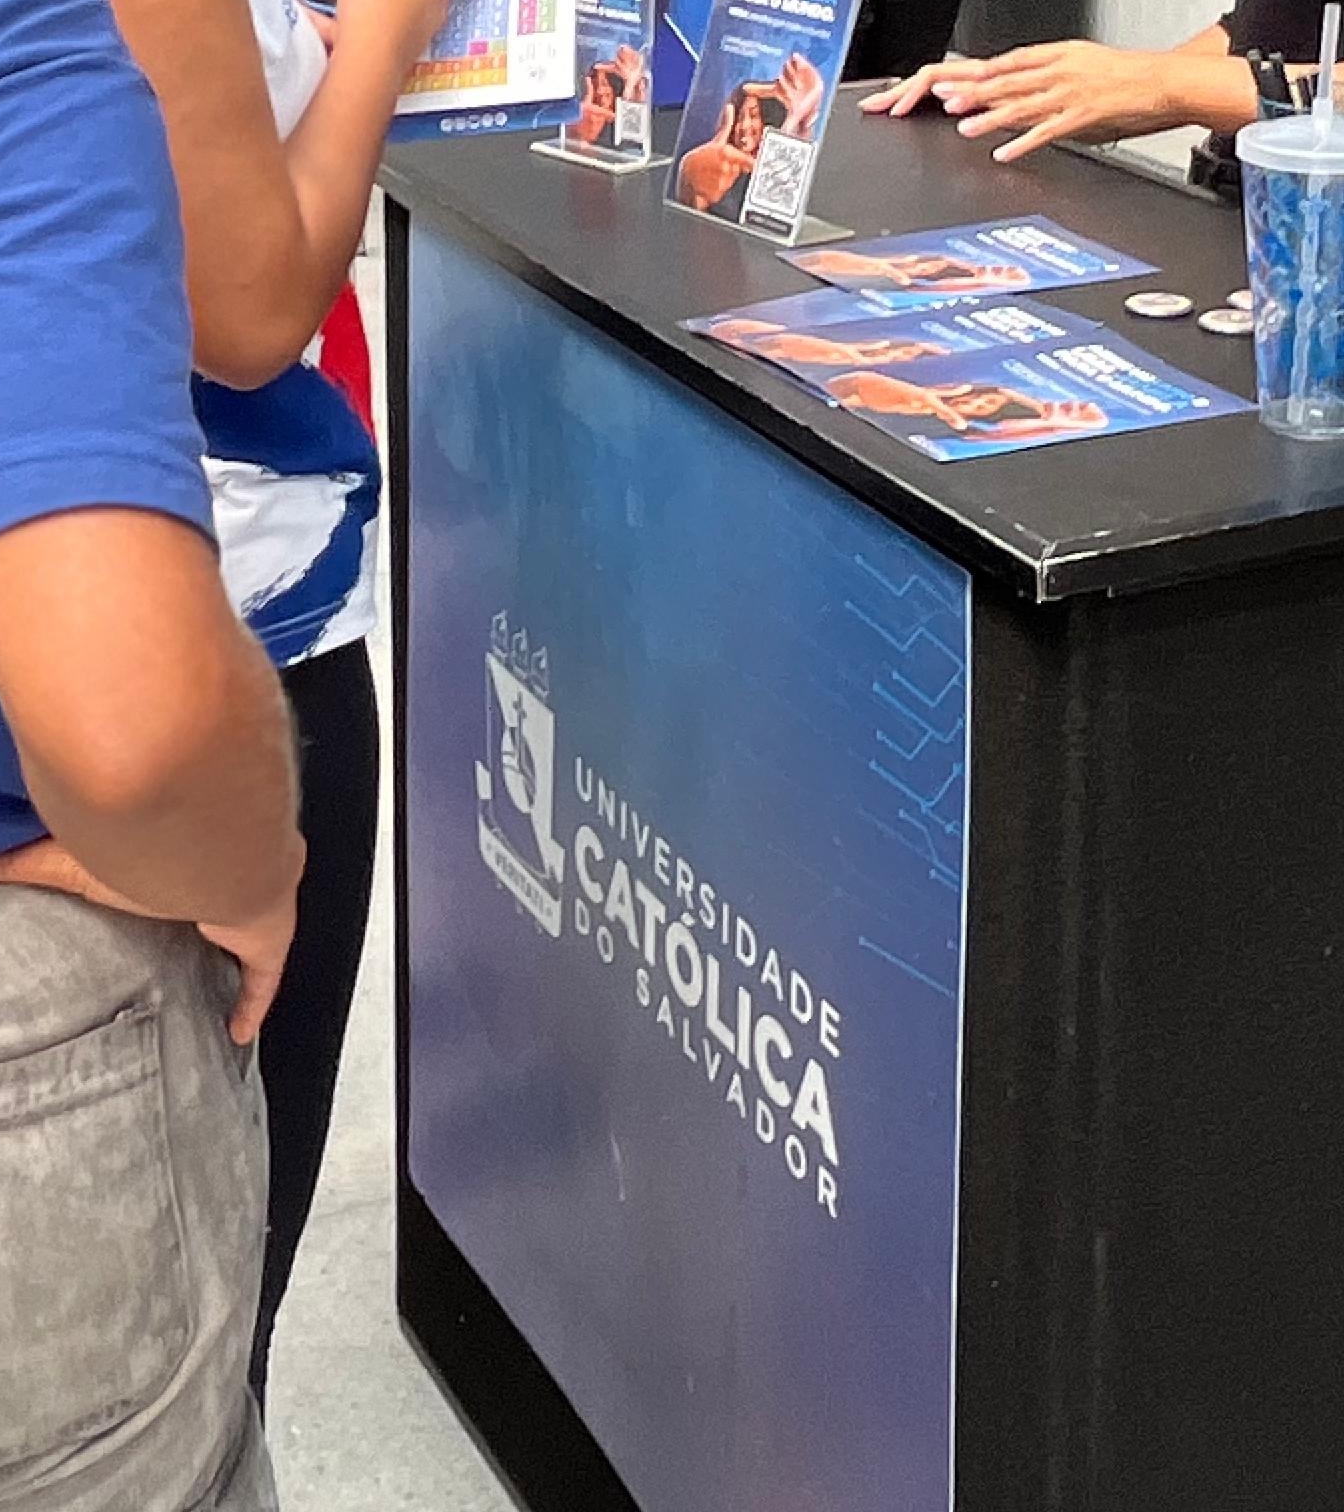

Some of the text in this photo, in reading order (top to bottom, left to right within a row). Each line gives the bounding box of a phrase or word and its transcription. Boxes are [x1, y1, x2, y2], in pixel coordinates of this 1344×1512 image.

[574, 755, 842, 1059] UNIVERSIDADE
[574, 825, 839, 1165] CATÓLICA
[574, 896, 839, 1219] DO SALVADOR
